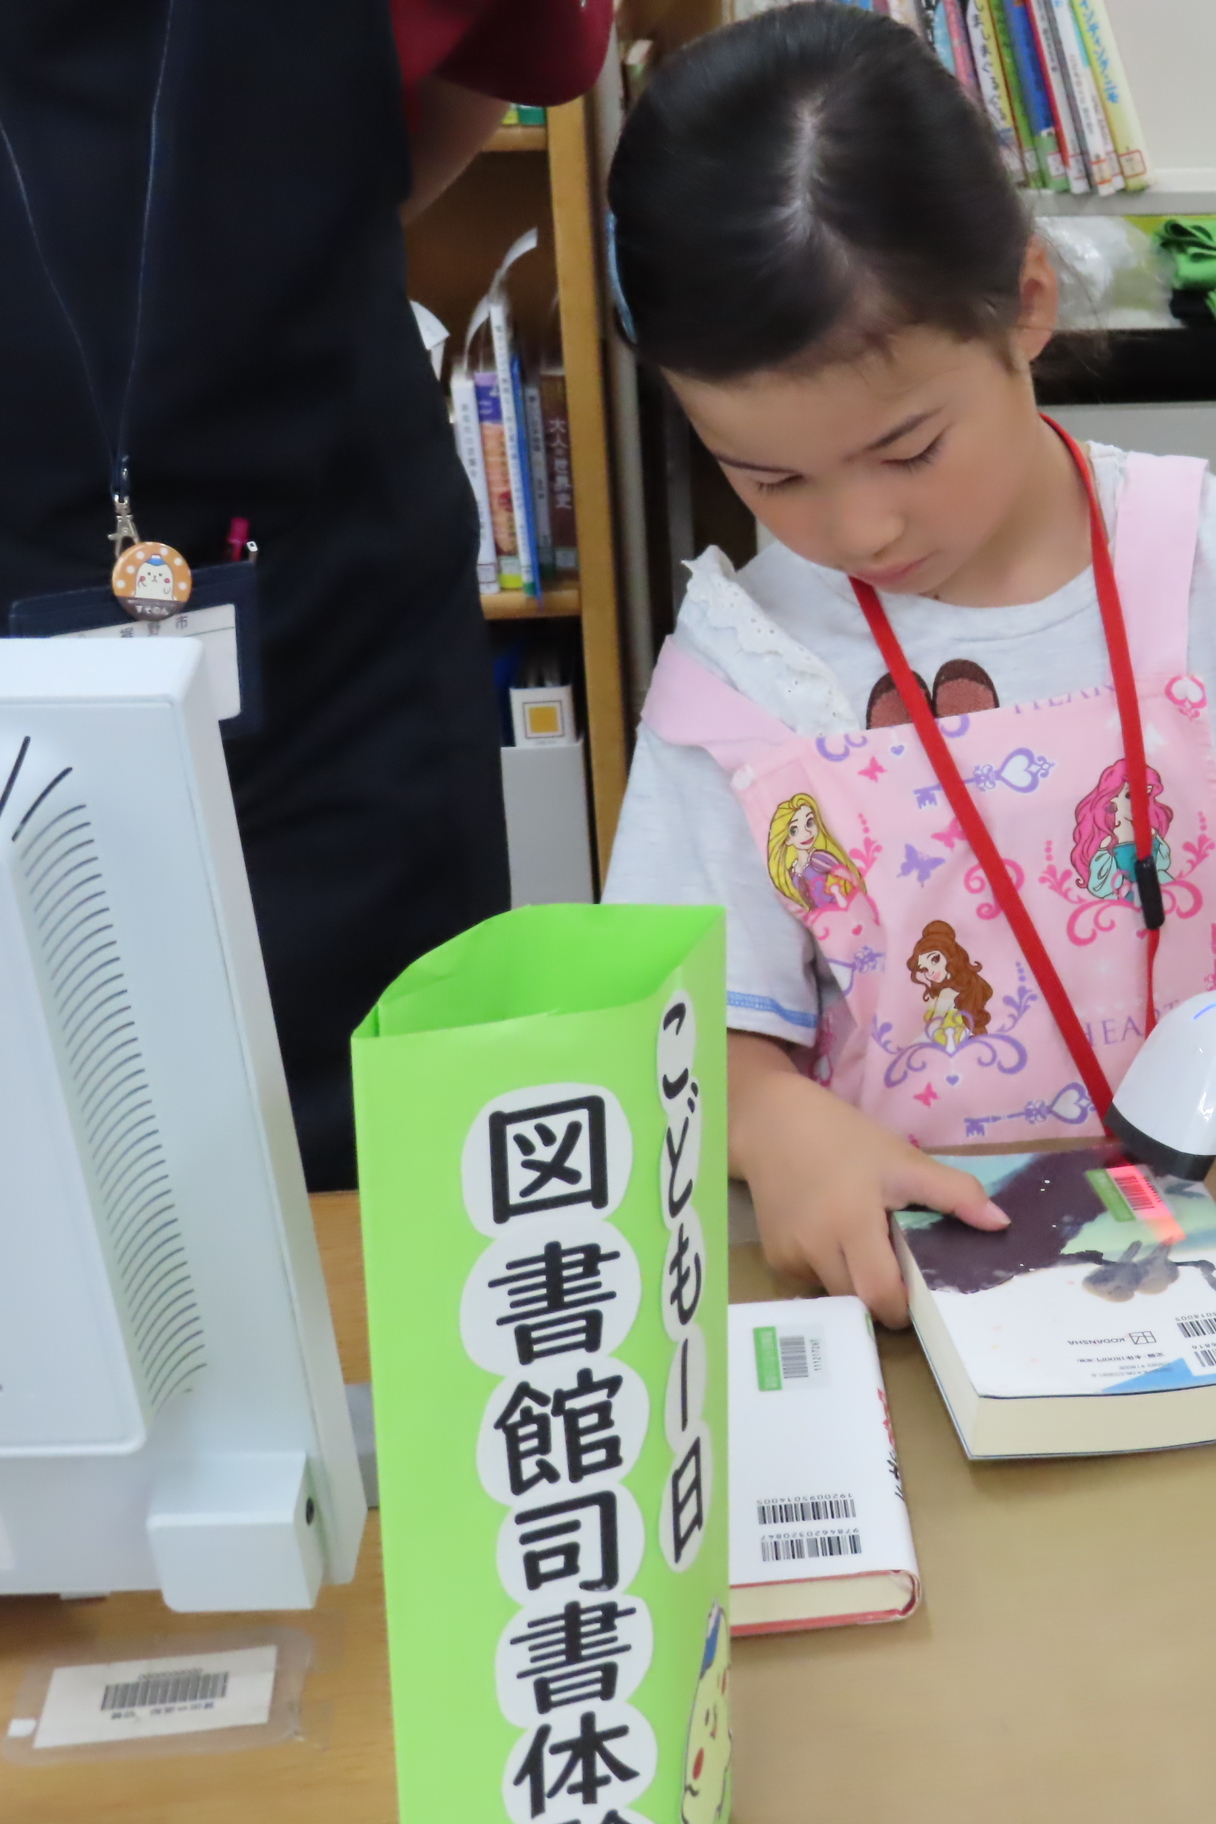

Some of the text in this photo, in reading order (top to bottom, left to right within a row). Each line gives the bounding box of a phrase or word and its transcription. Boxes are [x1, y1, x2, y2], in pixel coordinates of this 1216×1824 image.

[488, 1094, 641, 1824] 図書館司書体
[663, 1001, 702, 1563] こども一日
[1067, 1337, 1126, 1346] KODANSHA
